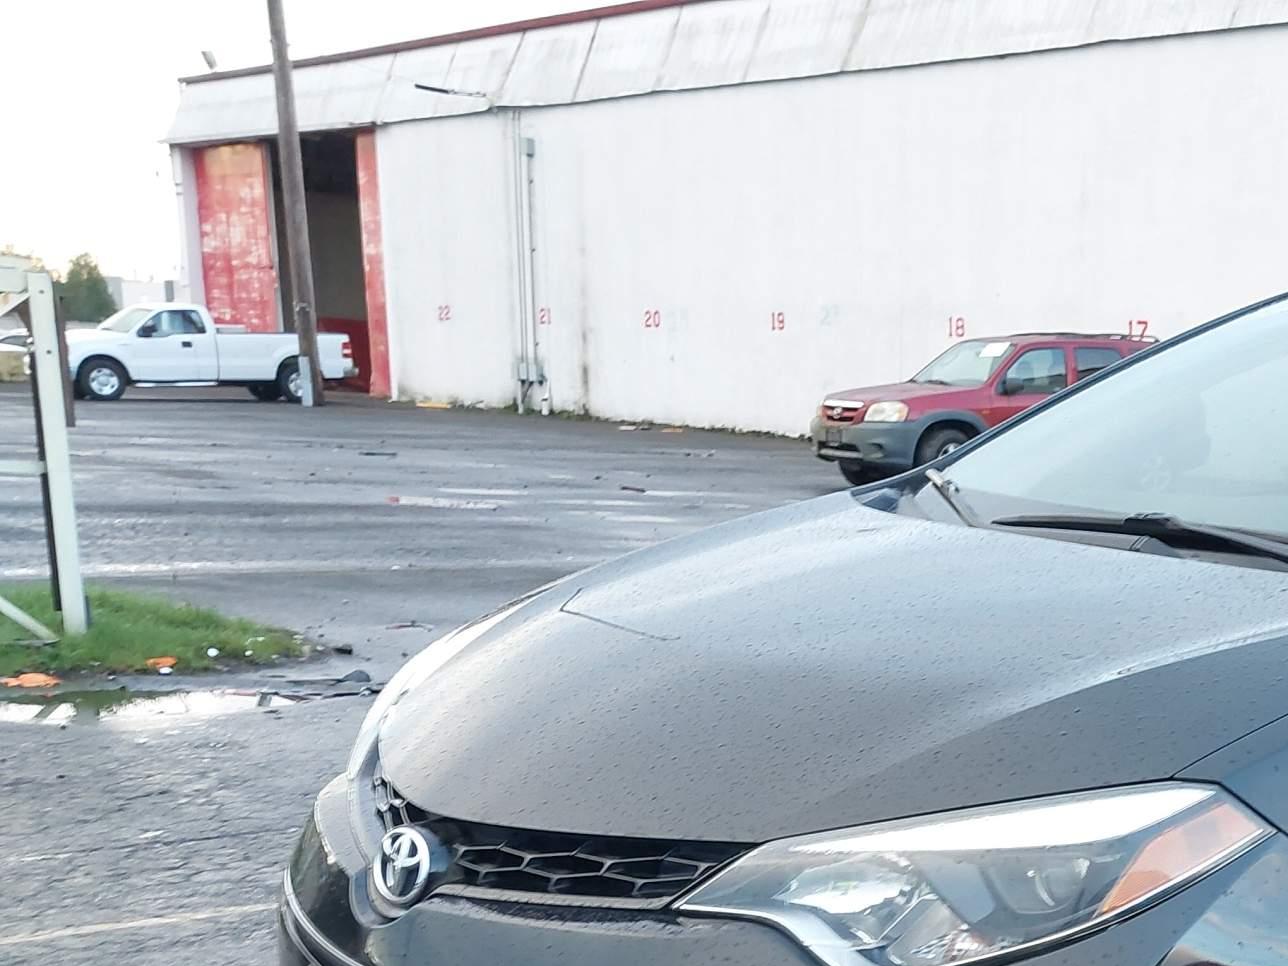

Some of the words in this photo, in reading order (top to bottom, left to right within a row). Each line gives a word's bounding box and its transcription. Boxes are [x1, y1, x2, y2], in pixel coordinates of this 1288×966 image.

[438, 304, 451, 321] 22
[539, 308, 552, 325] 21
[643, 309, 661, 328] 20
[771, 311, 785, 331] 19
[948, 316, 965, 337] 18
[1128, 319, 1149, 340] 17
